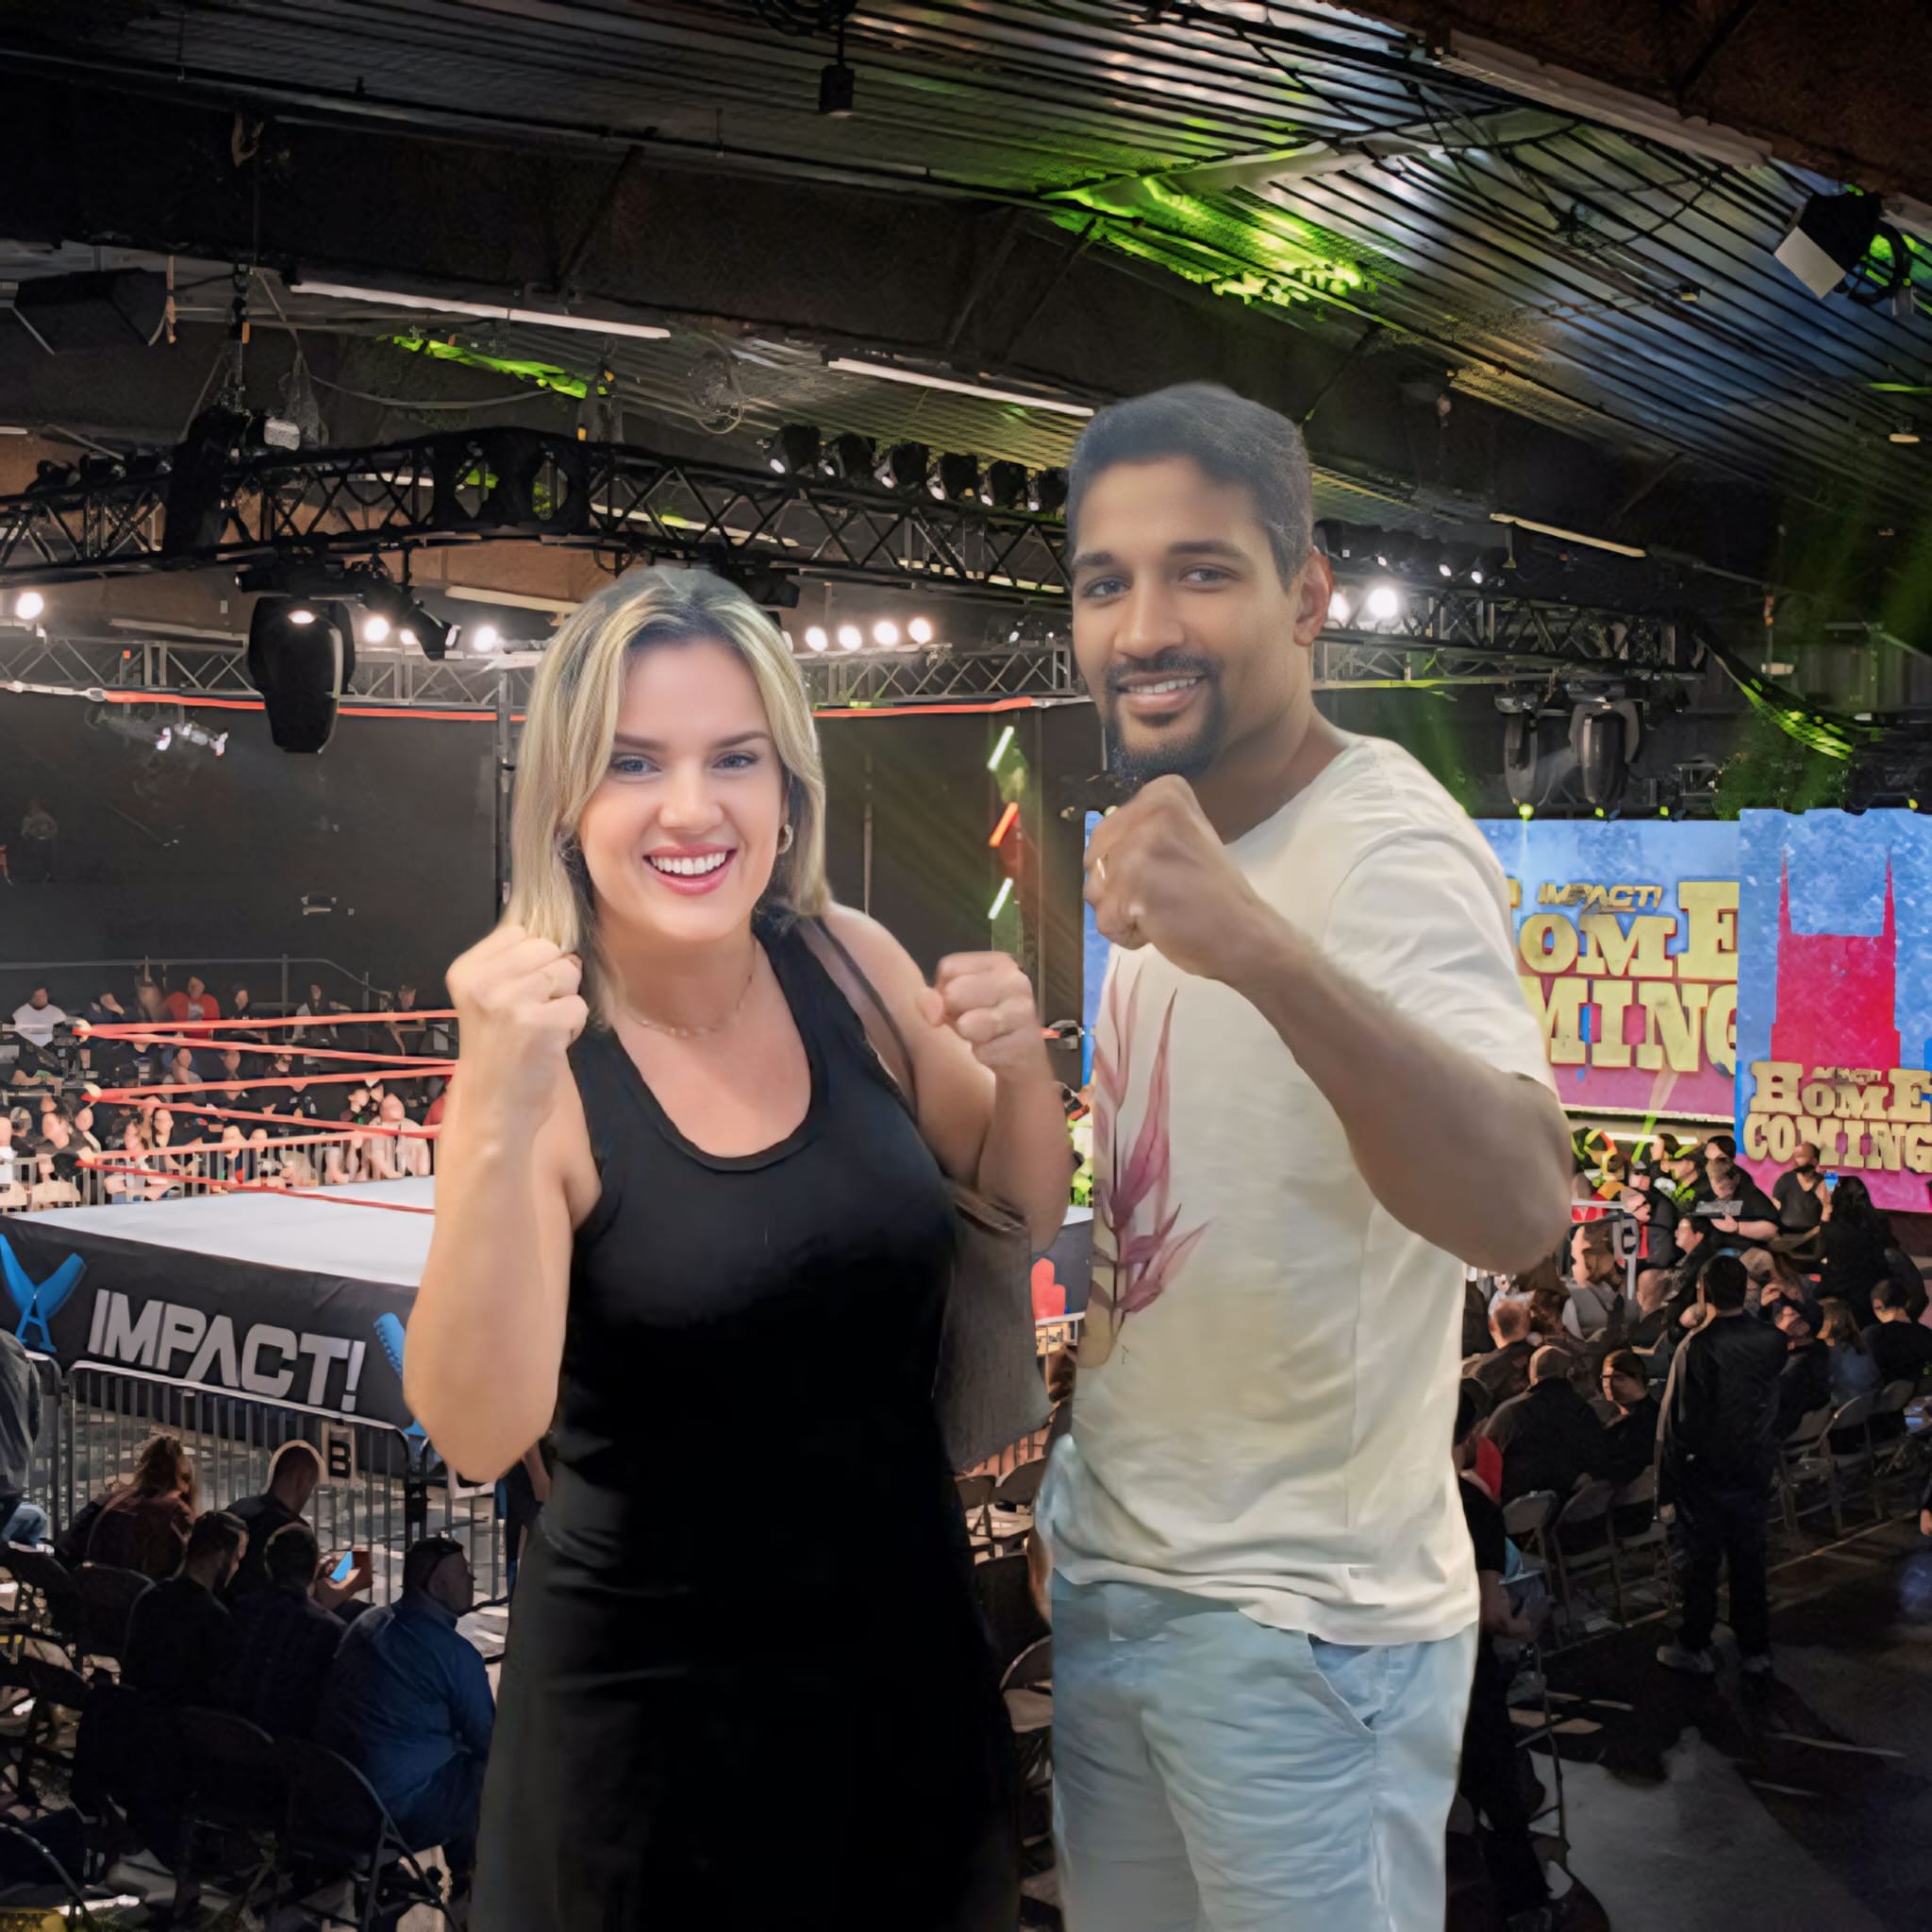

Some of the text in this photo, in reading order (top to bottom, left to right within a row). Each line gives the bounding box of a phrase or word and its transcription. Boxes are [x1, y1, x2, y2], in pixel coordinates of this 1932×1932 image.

[1507, 878, 1740, 980] OME
[1750, 1061, 1932, 1123] HOME
[1743, 1113, 1932, 1173] COMING
[87, 1289, 366, 1412] IMPACT!
